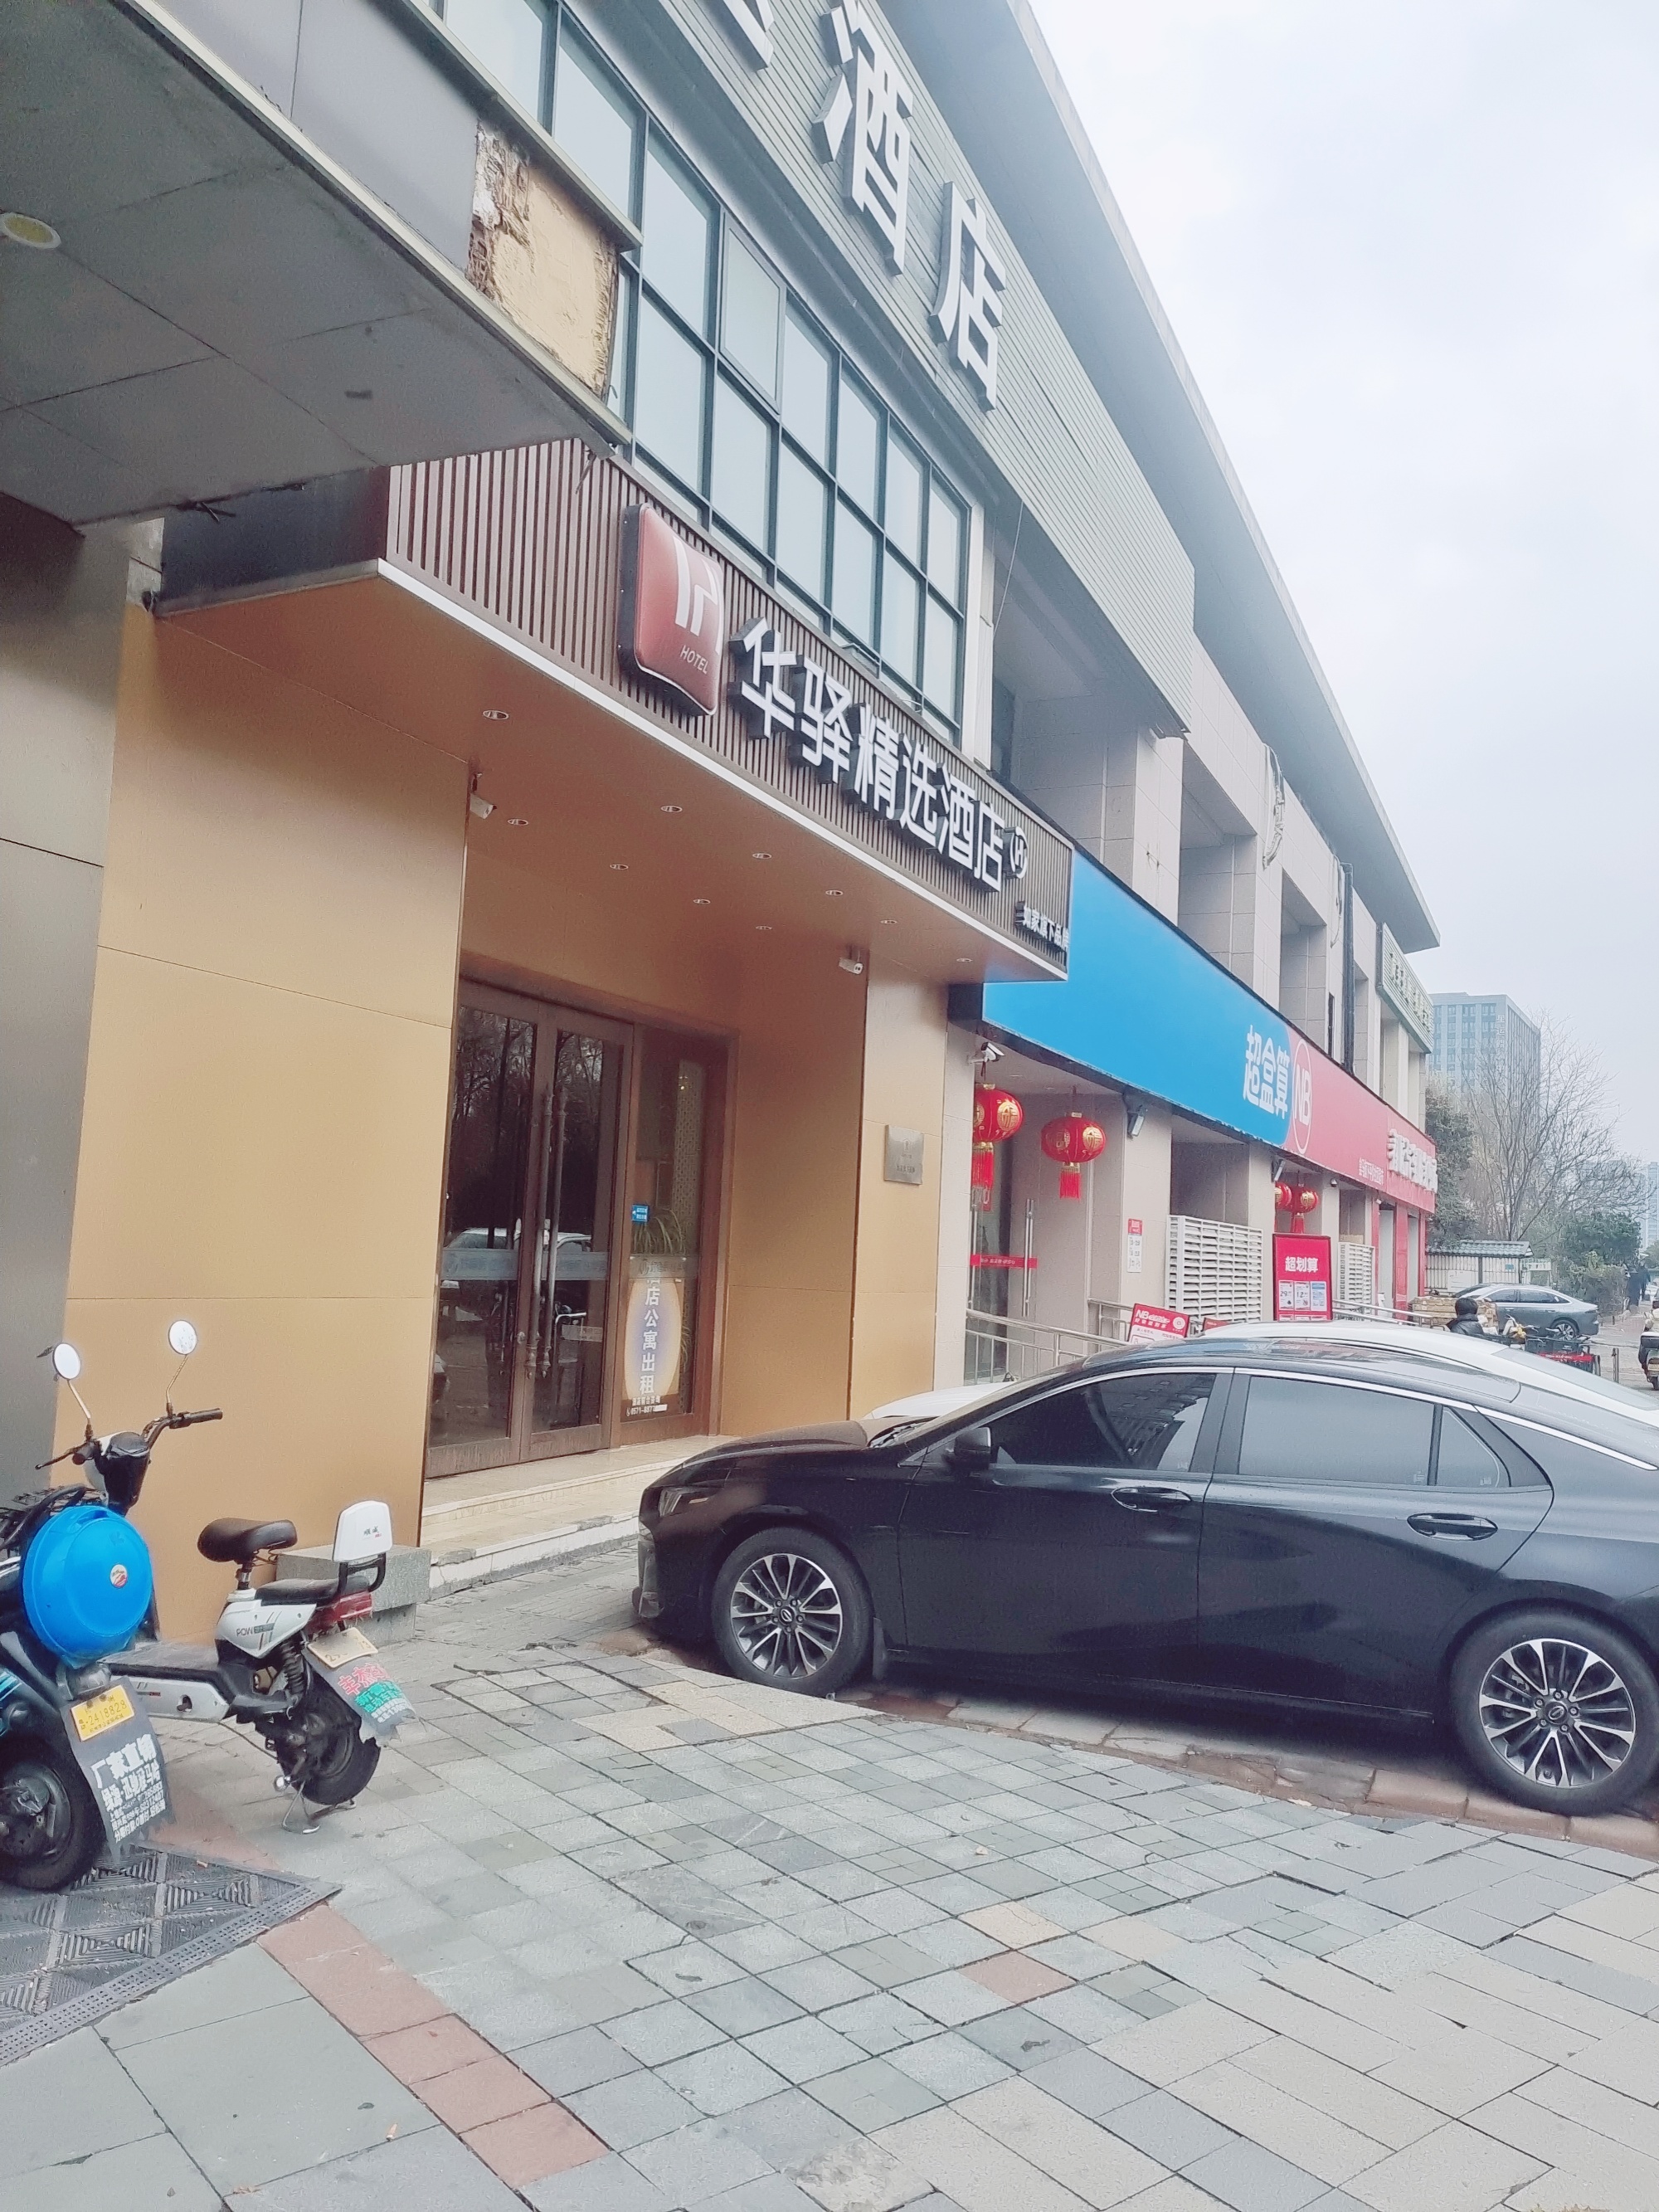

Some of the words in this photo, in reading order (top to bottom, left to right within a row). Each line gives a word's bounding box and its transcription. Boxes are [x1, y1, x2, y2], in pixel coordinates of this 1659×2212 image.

[679, 645, 708, 675] HOTEL
[740, 616, 1005, 892] 华驿精选酒店
[1243, 1024, 1290, 1120] 超盒算
[1294, 1065, 1311, 1126] NB
[1285, 1256, 1318, 1273] 超划算
[640, 1279, 661, 1395] 店公寓出租
